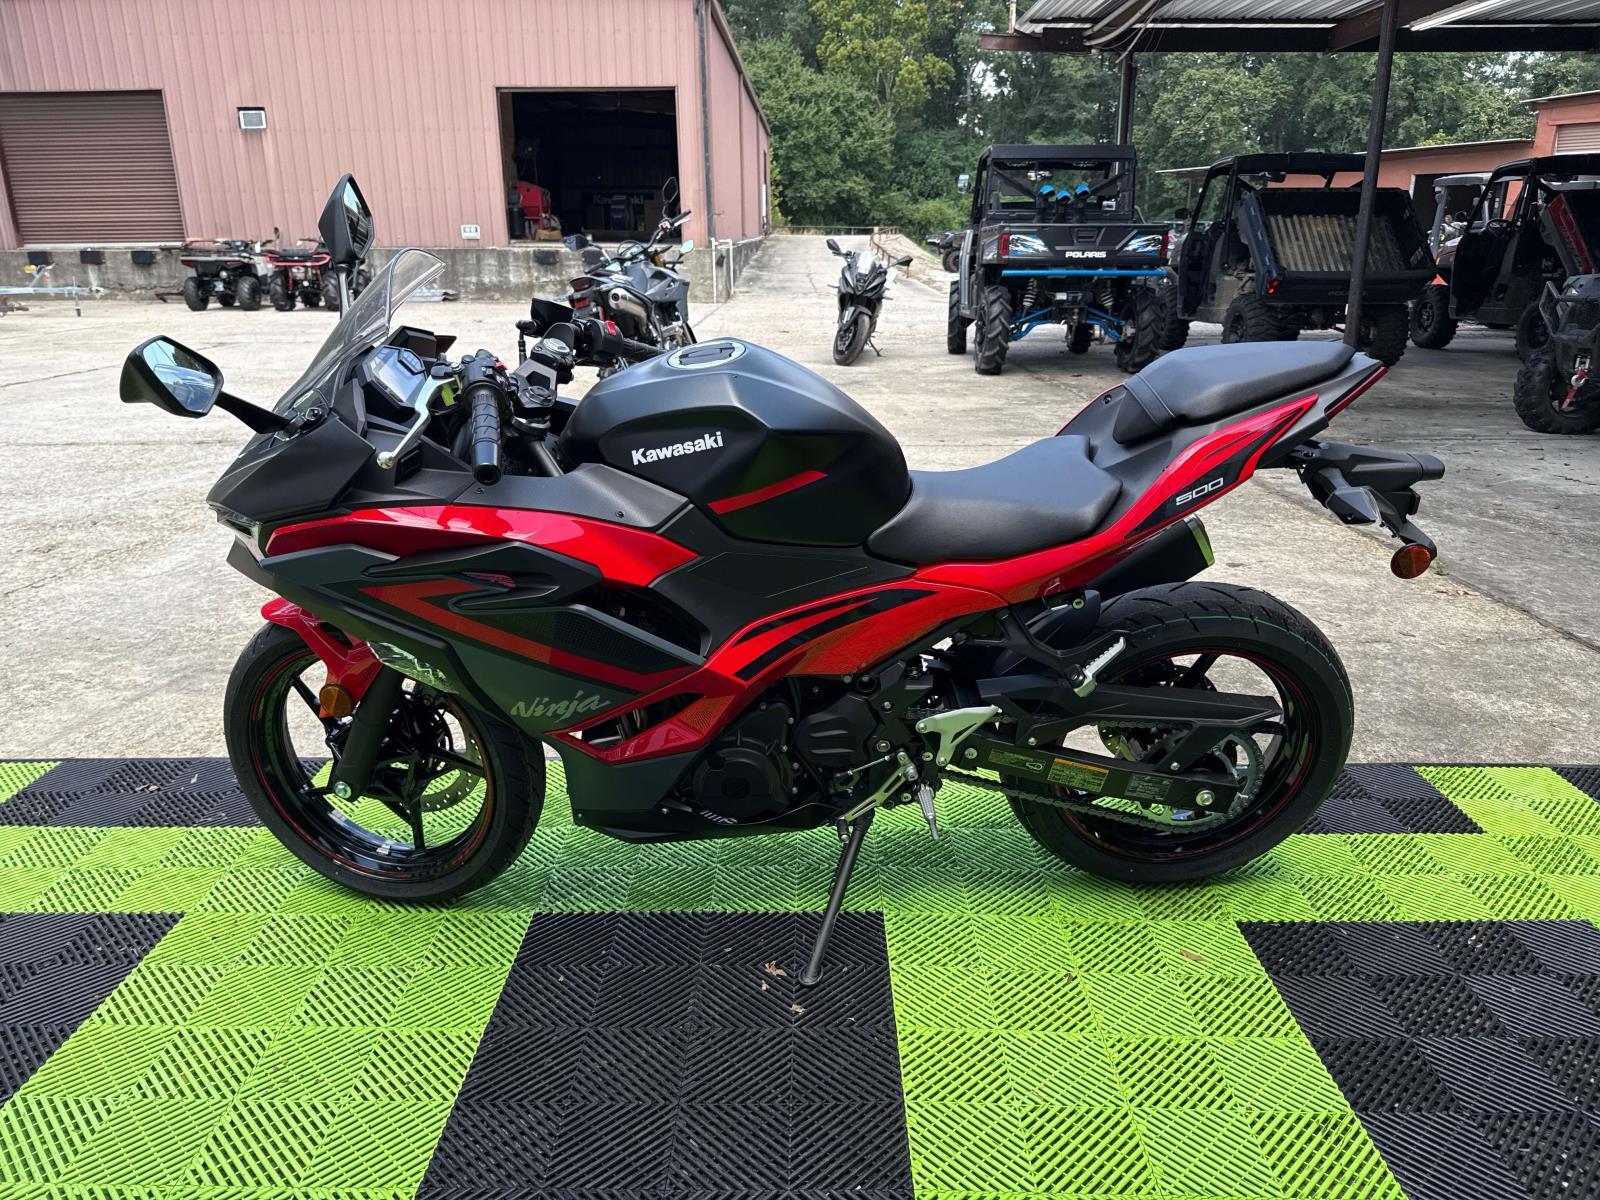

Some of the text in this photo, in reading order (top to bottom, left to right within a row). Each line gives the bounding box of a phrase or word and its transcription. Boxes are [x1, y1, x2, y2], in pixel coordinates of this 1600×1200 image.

[1065, 251, 1106, 259] POLARIS
[631, 431, 724, 466] Kawasaki
[1176, 477, 1224, 505] 500
[510, 690, 611, 723] Ninja
